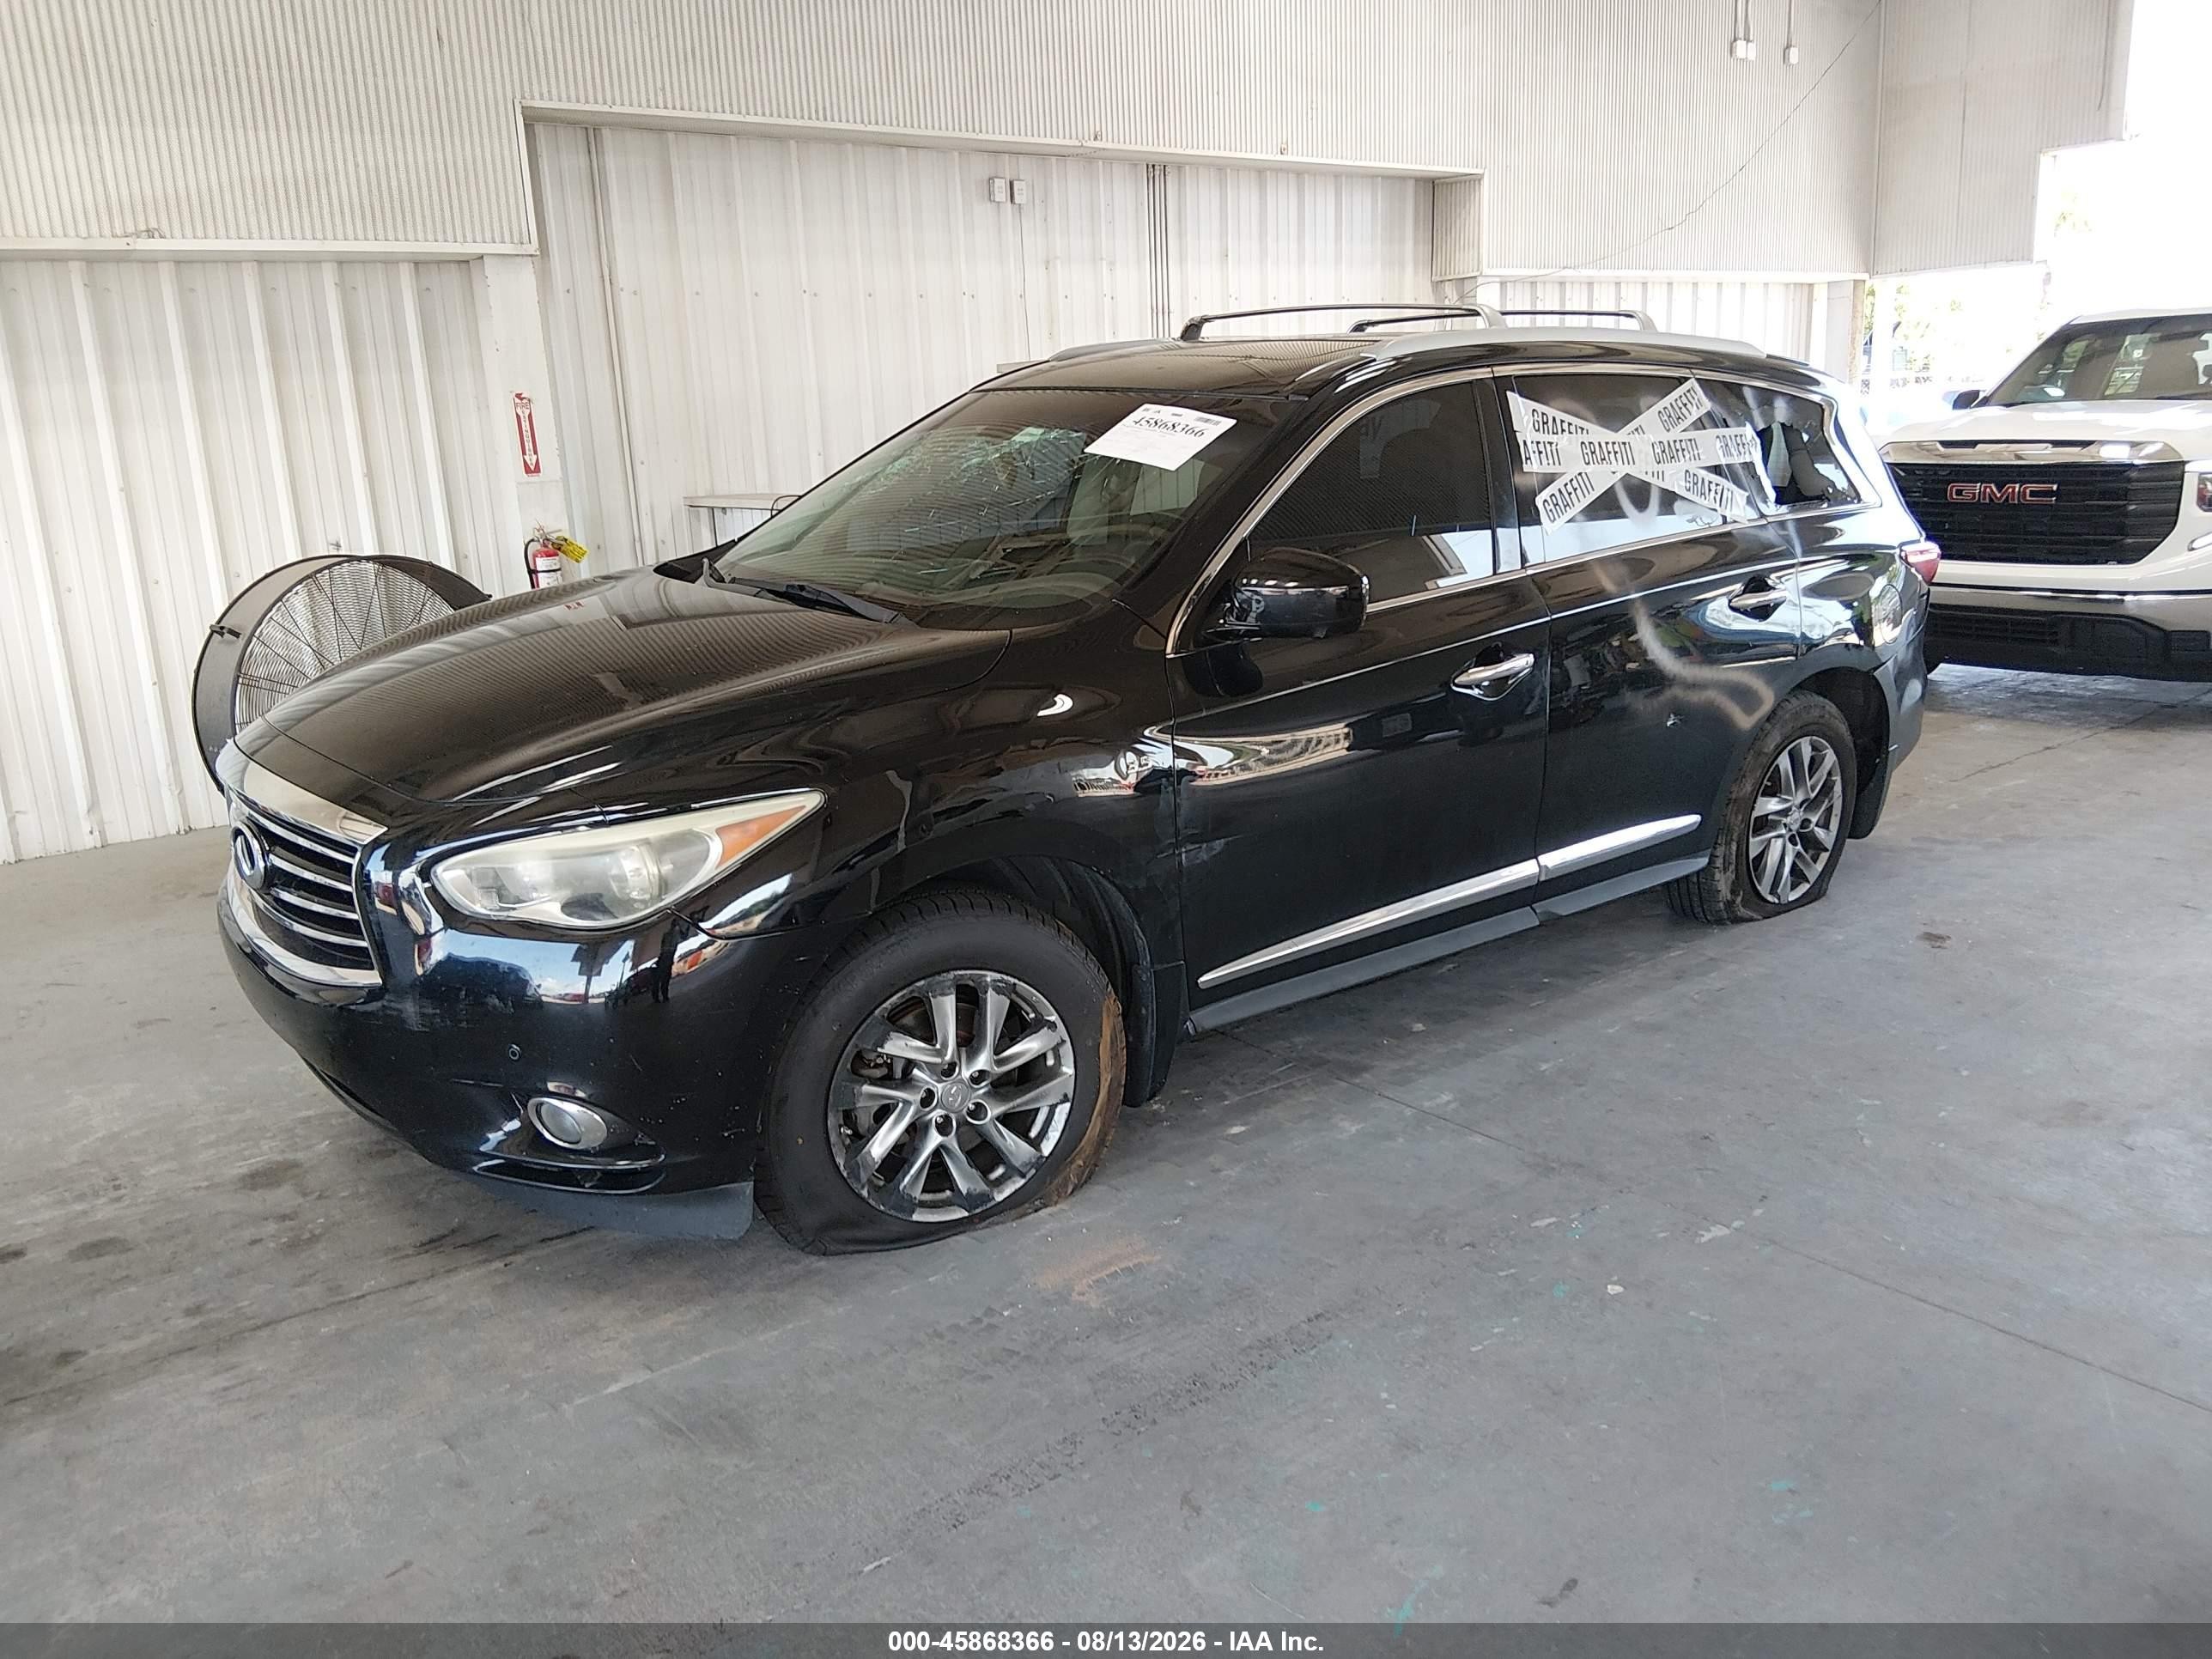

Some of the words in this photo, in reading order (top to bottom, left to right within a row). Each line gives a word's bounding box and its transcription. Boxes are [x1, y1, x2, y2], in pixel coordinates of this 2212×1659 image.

[515, 401, 530, 410] FIRE
[1657, 386, 1703, 433] GRAFFITI
[1133, 416, 1206, 438] 45868366
[1531, 408, 1590, 435] GRAFF
[1580, 441, 1636, 465] GRAFFITI
[1651, 438, 1702, 465] GRAFFITI
[1542, 471, 1595, 524] GRAFFITI
[1684, 469, 1735, 513] GRAFFITI
[1948, 483, 2057, 503] GMC
